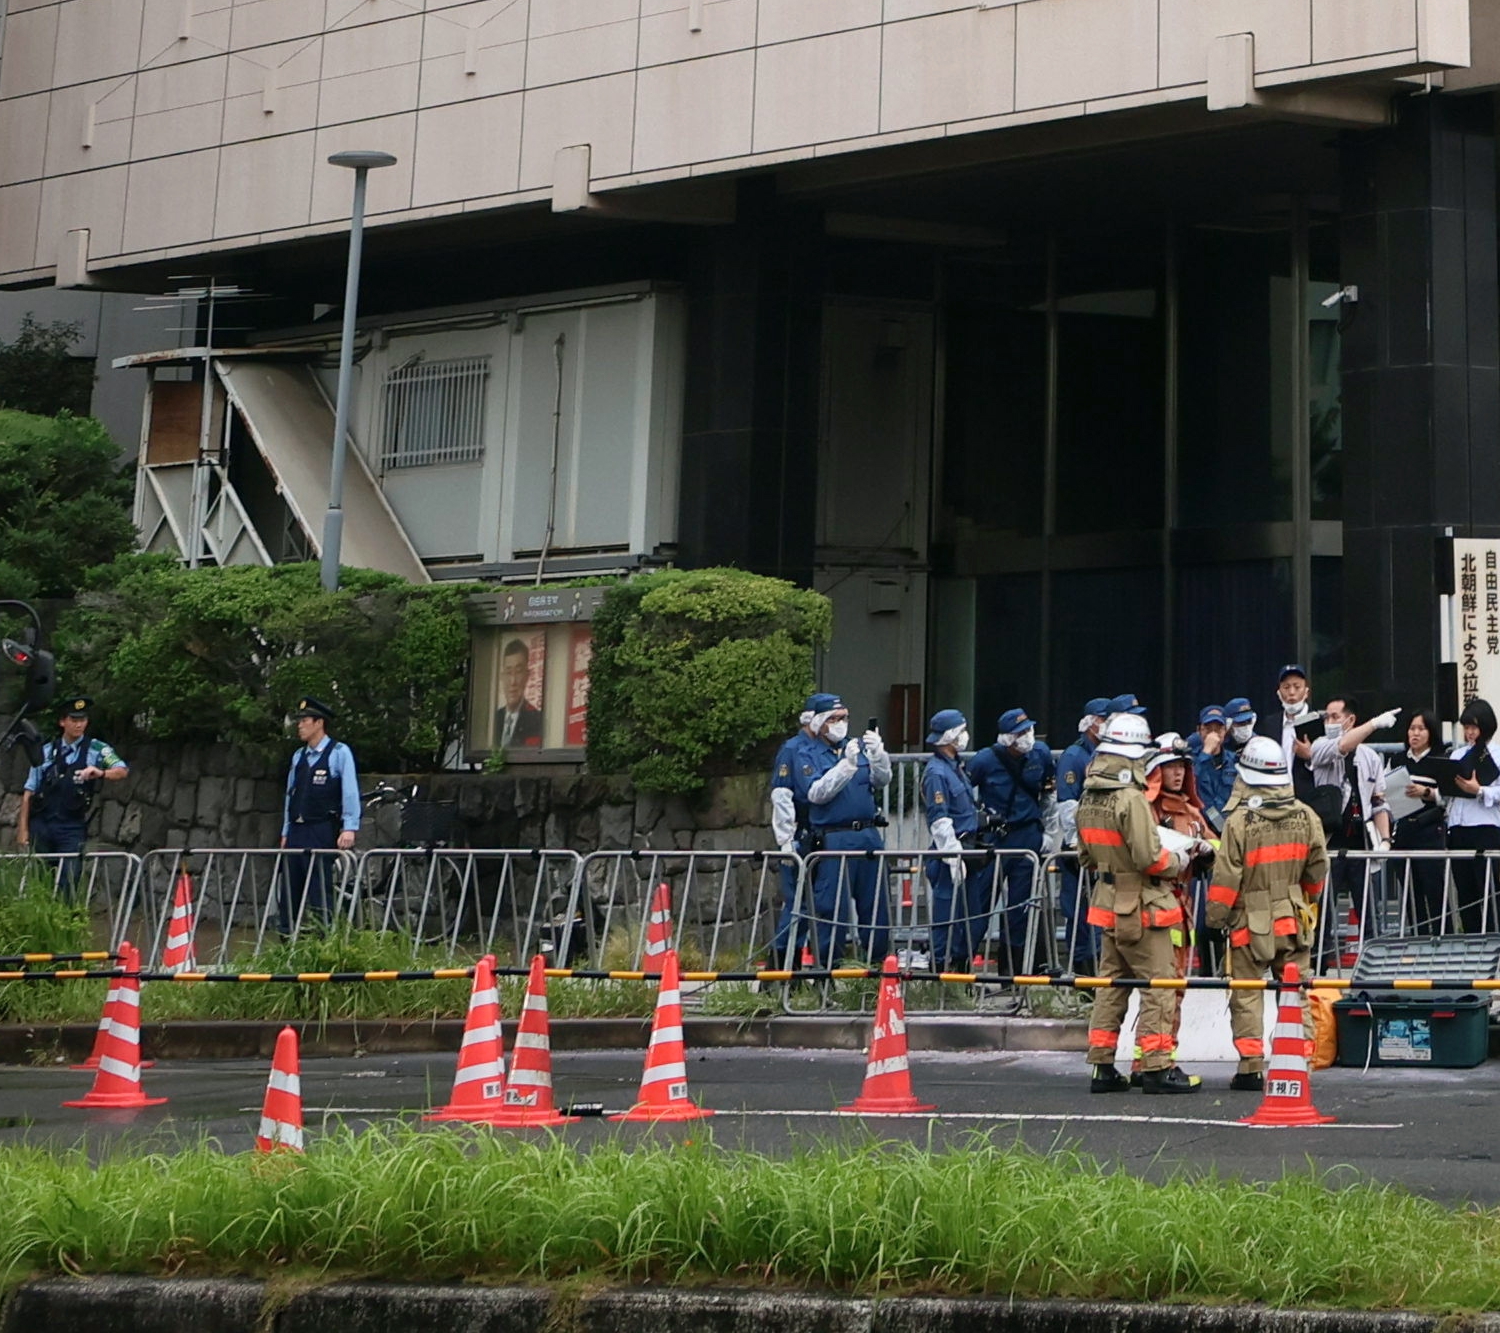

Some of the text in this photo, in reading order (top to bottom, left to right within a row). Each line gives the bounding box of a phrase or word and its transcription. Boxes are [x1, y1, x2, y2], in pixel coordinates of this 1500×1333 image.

[1485, 549, 1500, 656] 自由民主党
